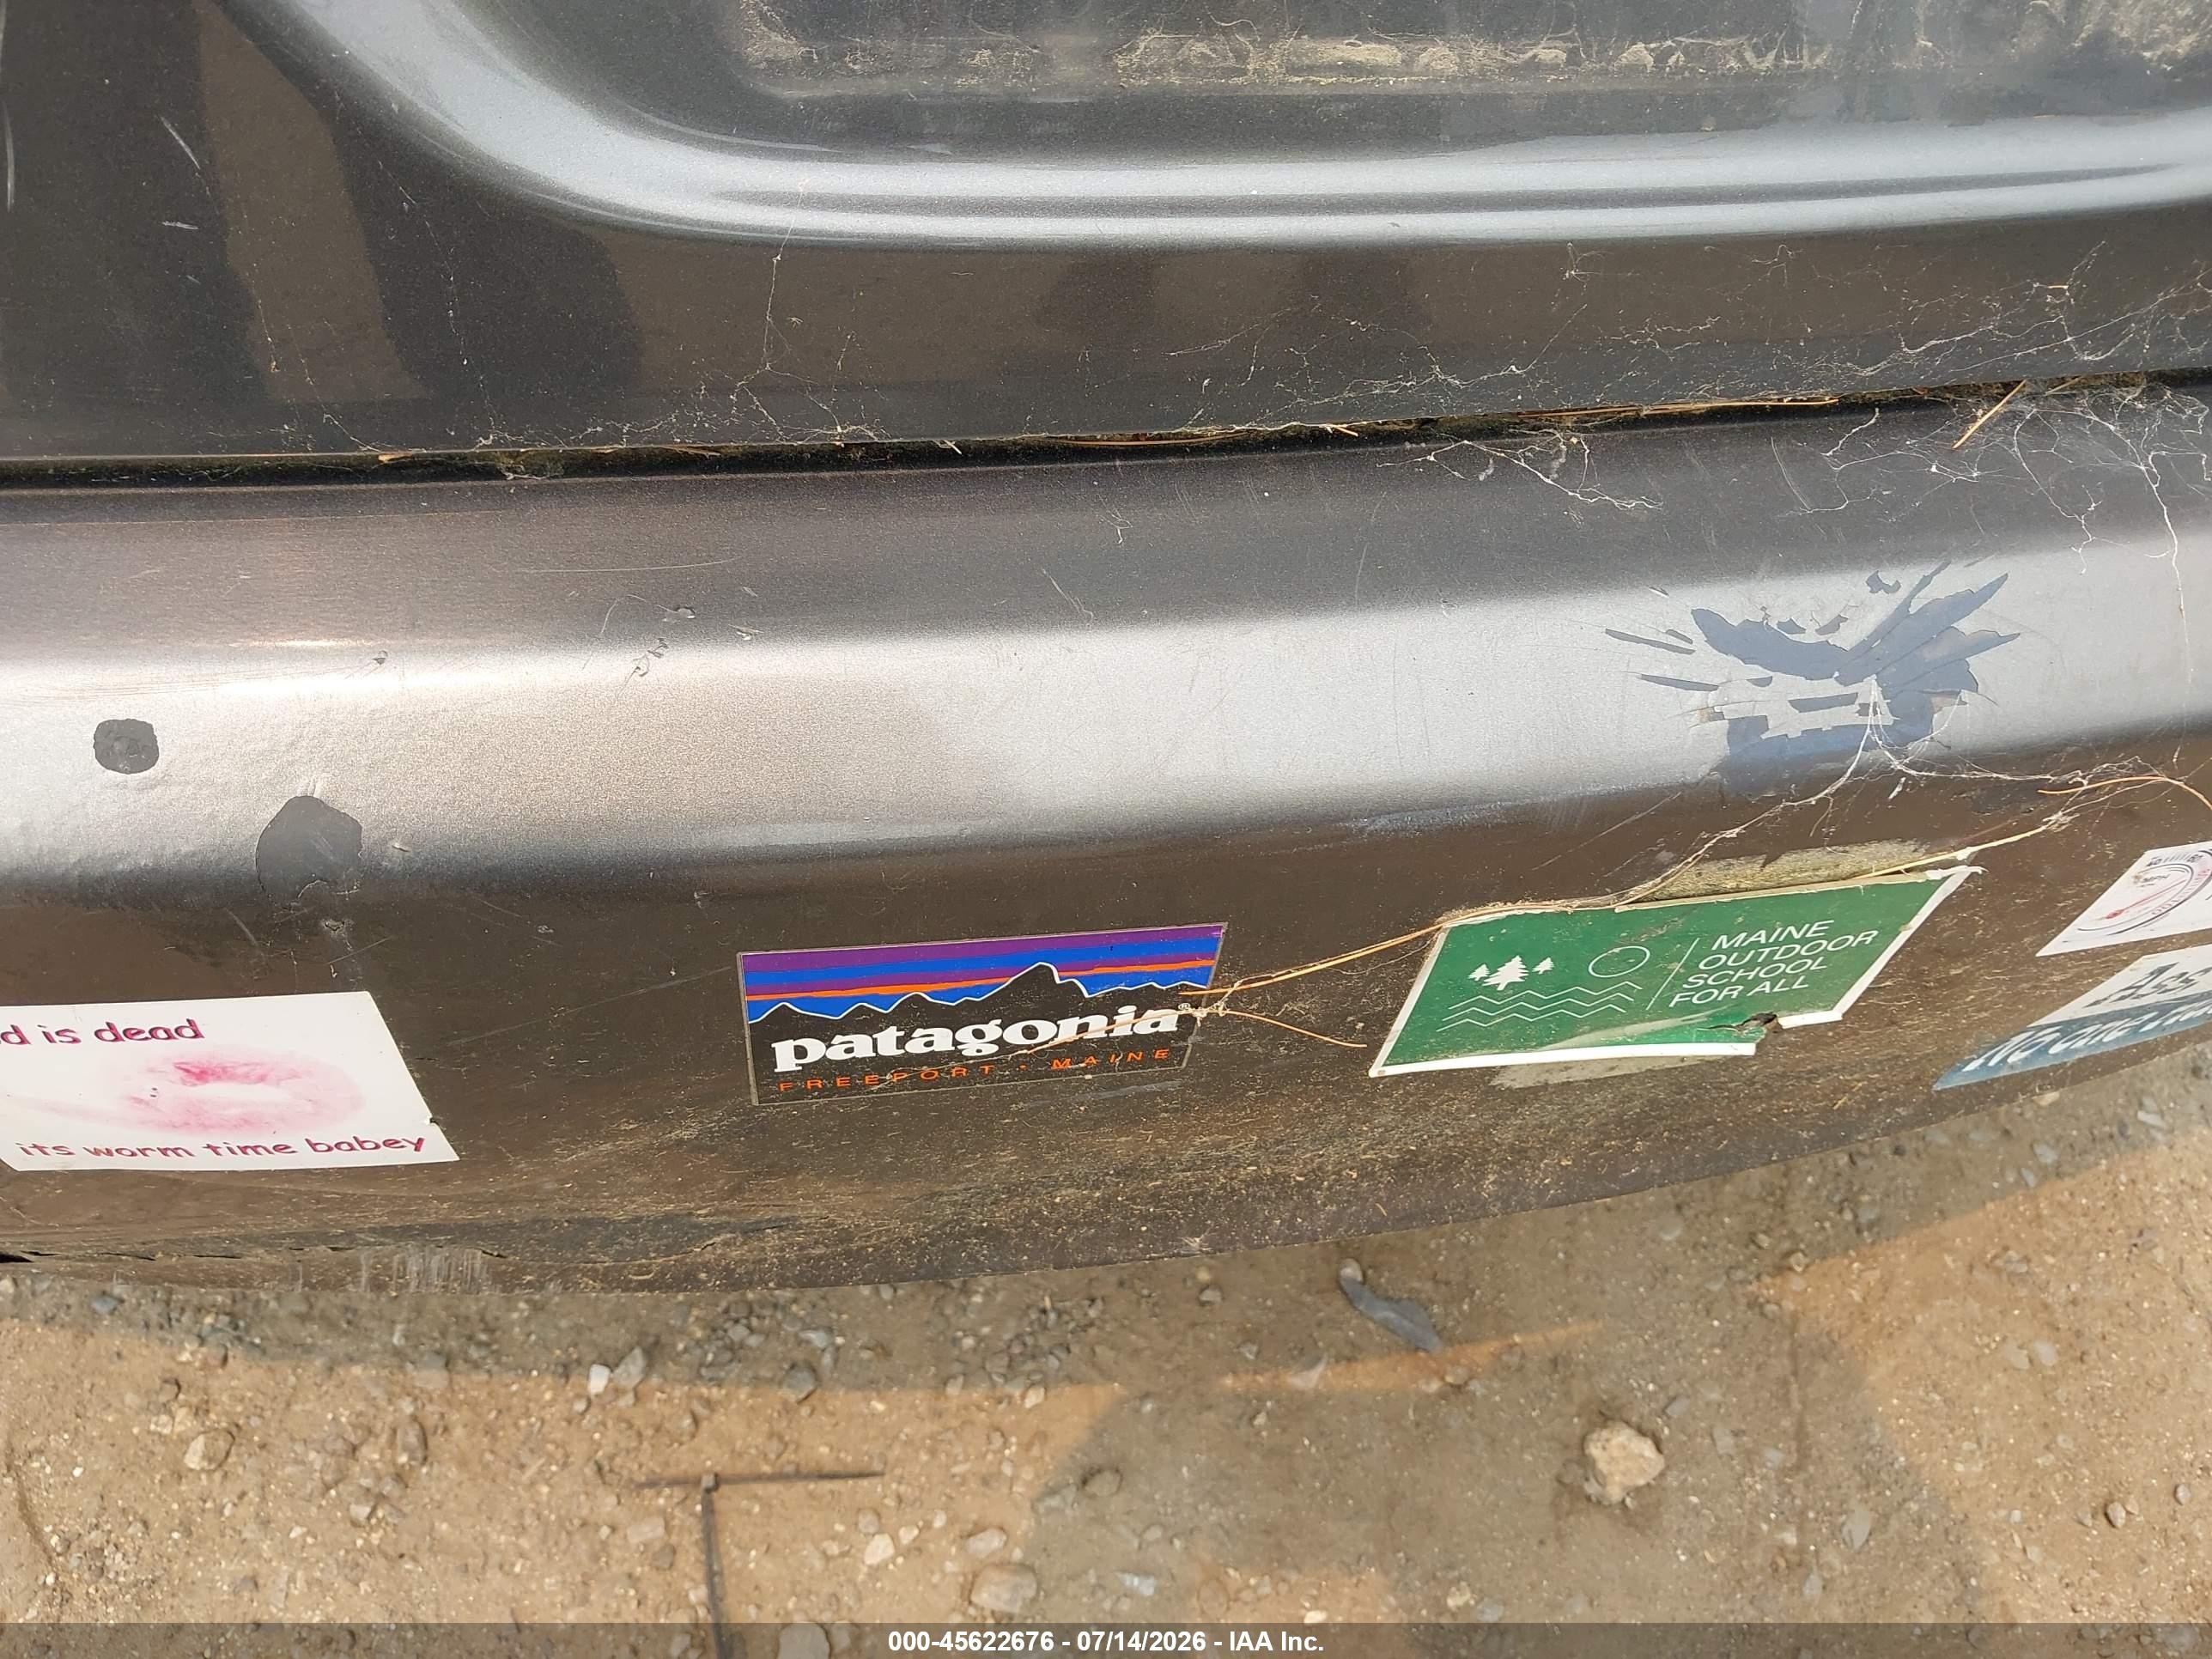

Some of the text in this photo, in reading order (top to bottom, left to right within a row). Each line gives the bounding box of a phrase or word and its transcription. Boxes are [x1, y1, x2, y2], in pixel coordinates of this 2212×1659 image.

[1698, 930, 1879, 970] OUTDOOR
[1711, 920, 1834, 951] MAINE
[1682, 957, 1827, 988] SCHOOL
[1668, 975, 1809, 1008] FOR ALL
[0, 1018, 206, 1046] d is dead
[771, 1005, 1179, 1073] patagonia
[778, 1048, 1170, 1092] FREEPORT MAINE
[19, 1134, 427, 1158] its worm time babey
